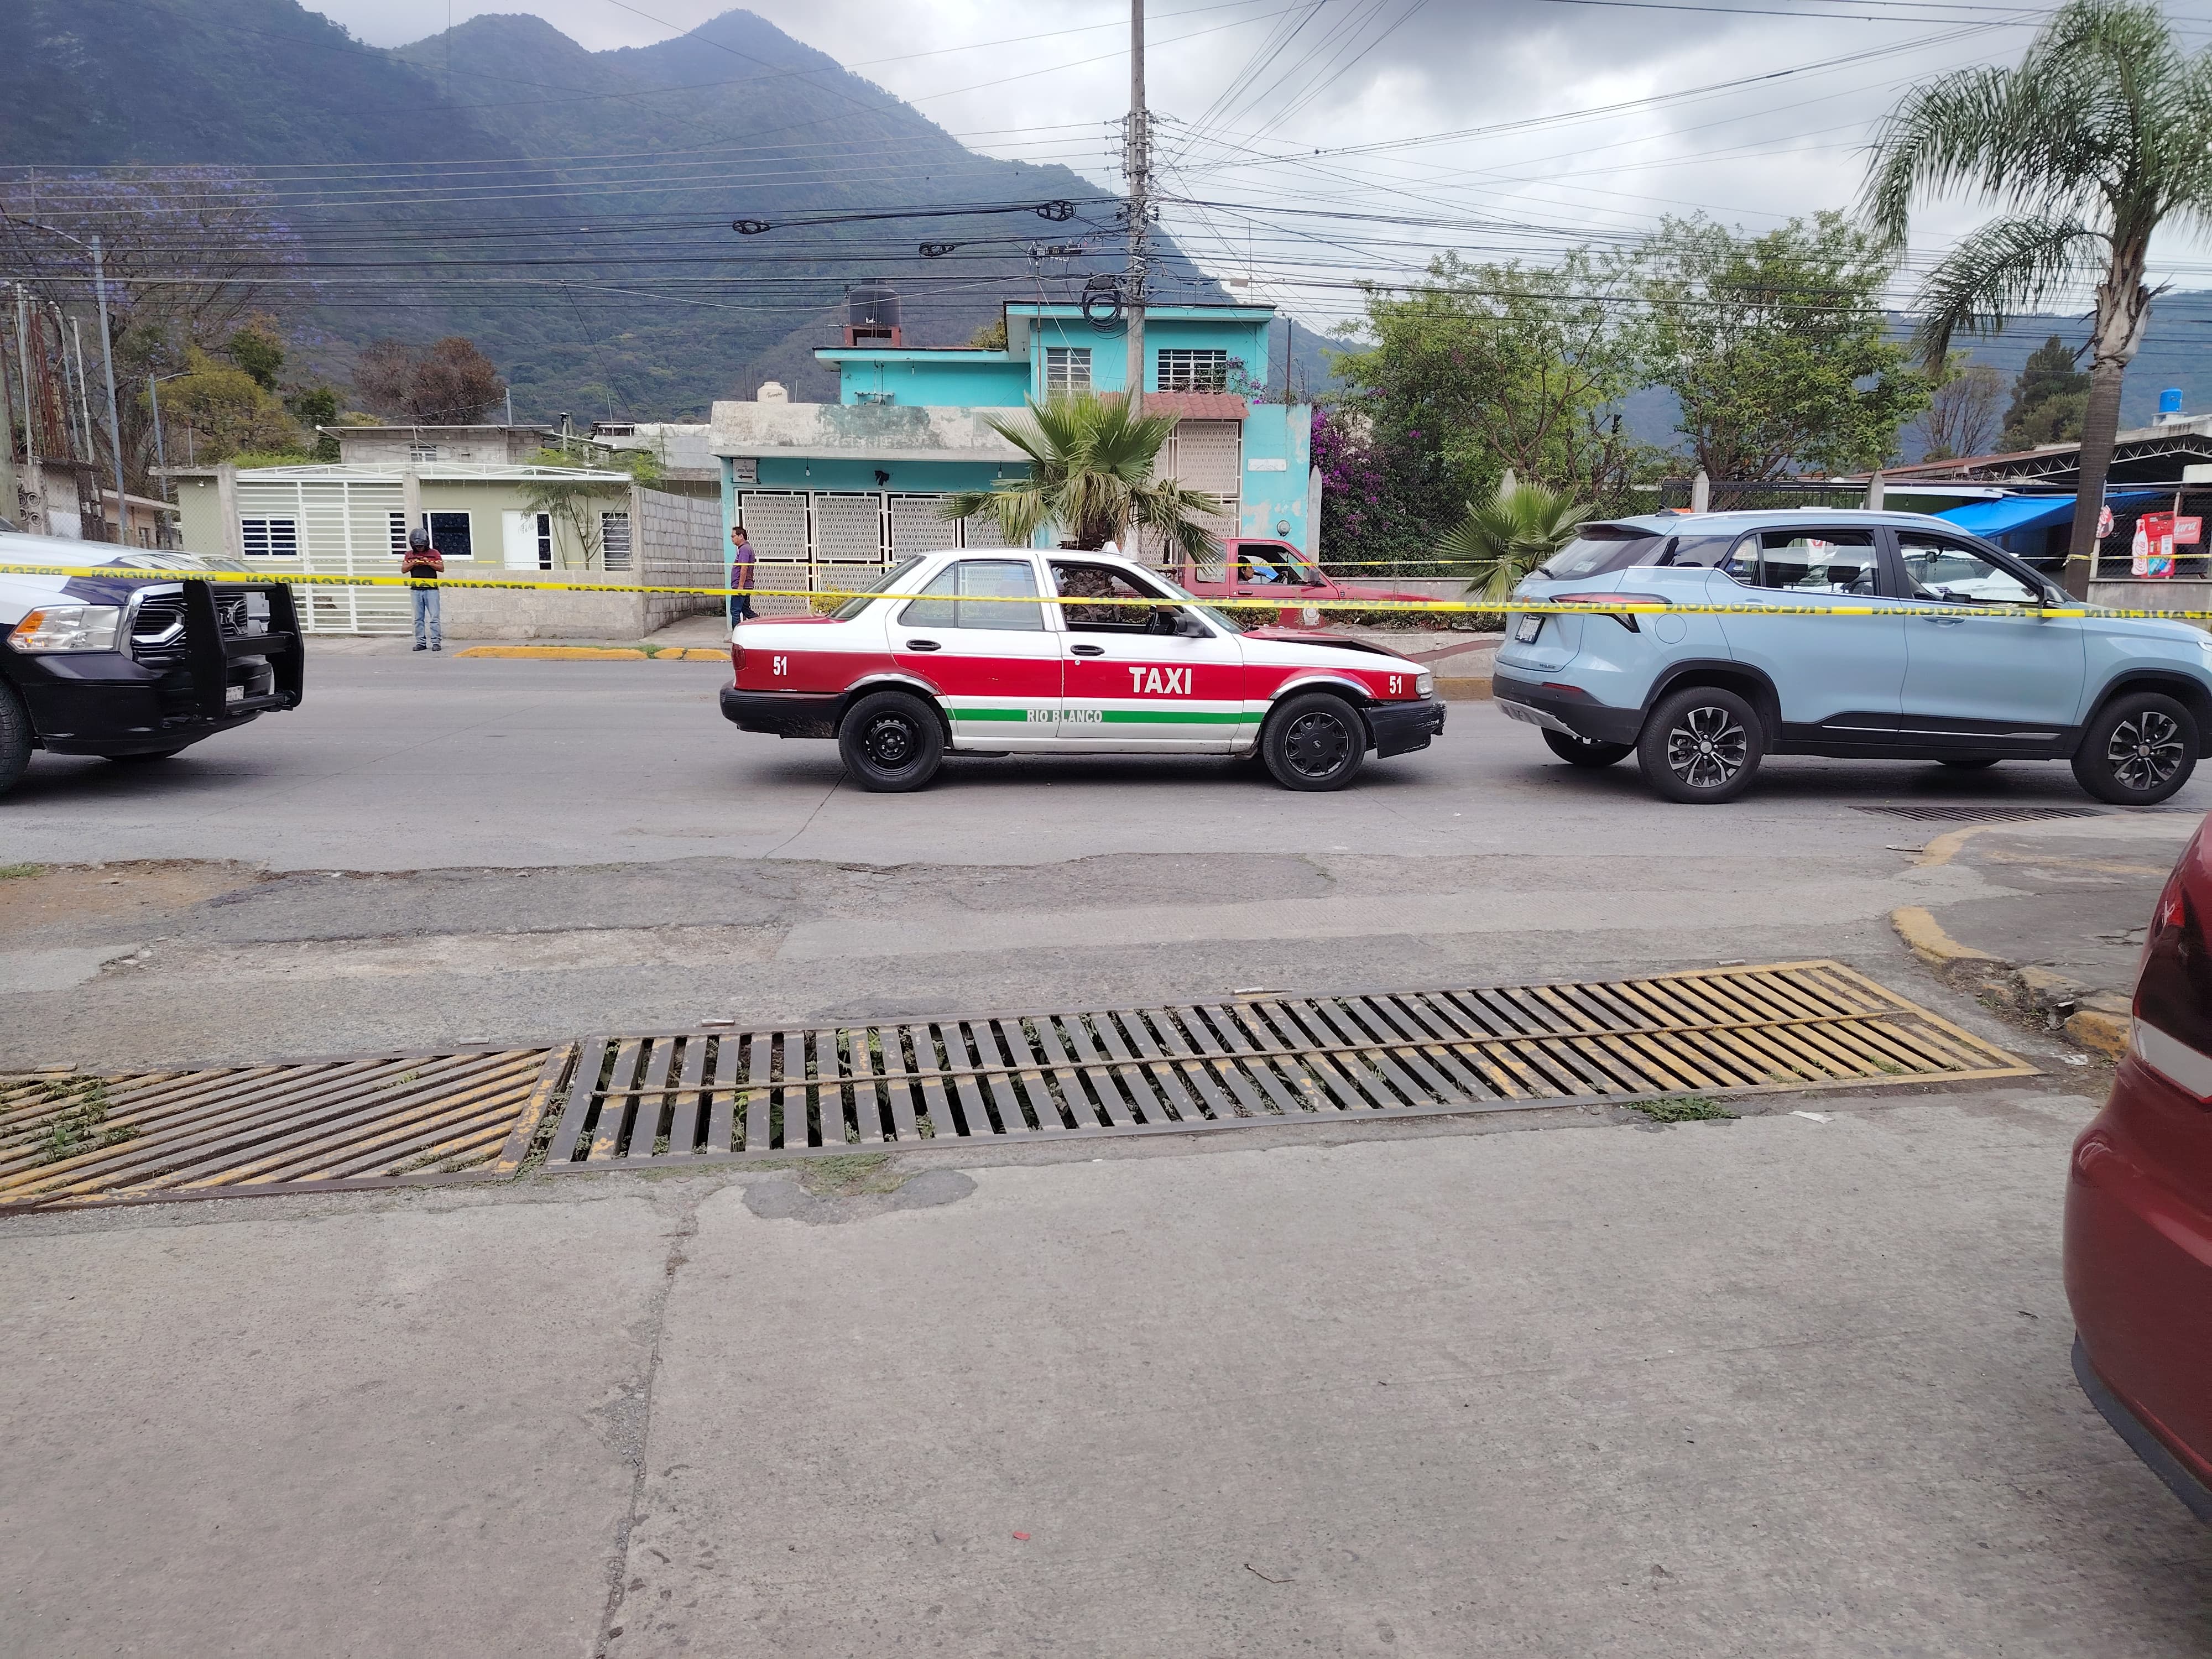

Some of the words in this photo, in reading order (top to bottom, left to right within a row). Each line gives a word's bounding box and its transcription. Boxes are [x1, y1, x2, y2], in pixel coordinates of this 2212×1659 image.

[773, 656, 787, 676] 51
[1129, 666, 1192, 695] TAXI
[1389, 675, 1402, 694] 51
[1027, 709, 1048, 722] RIO
[1052, 709, 1103, 723] BLANCO
